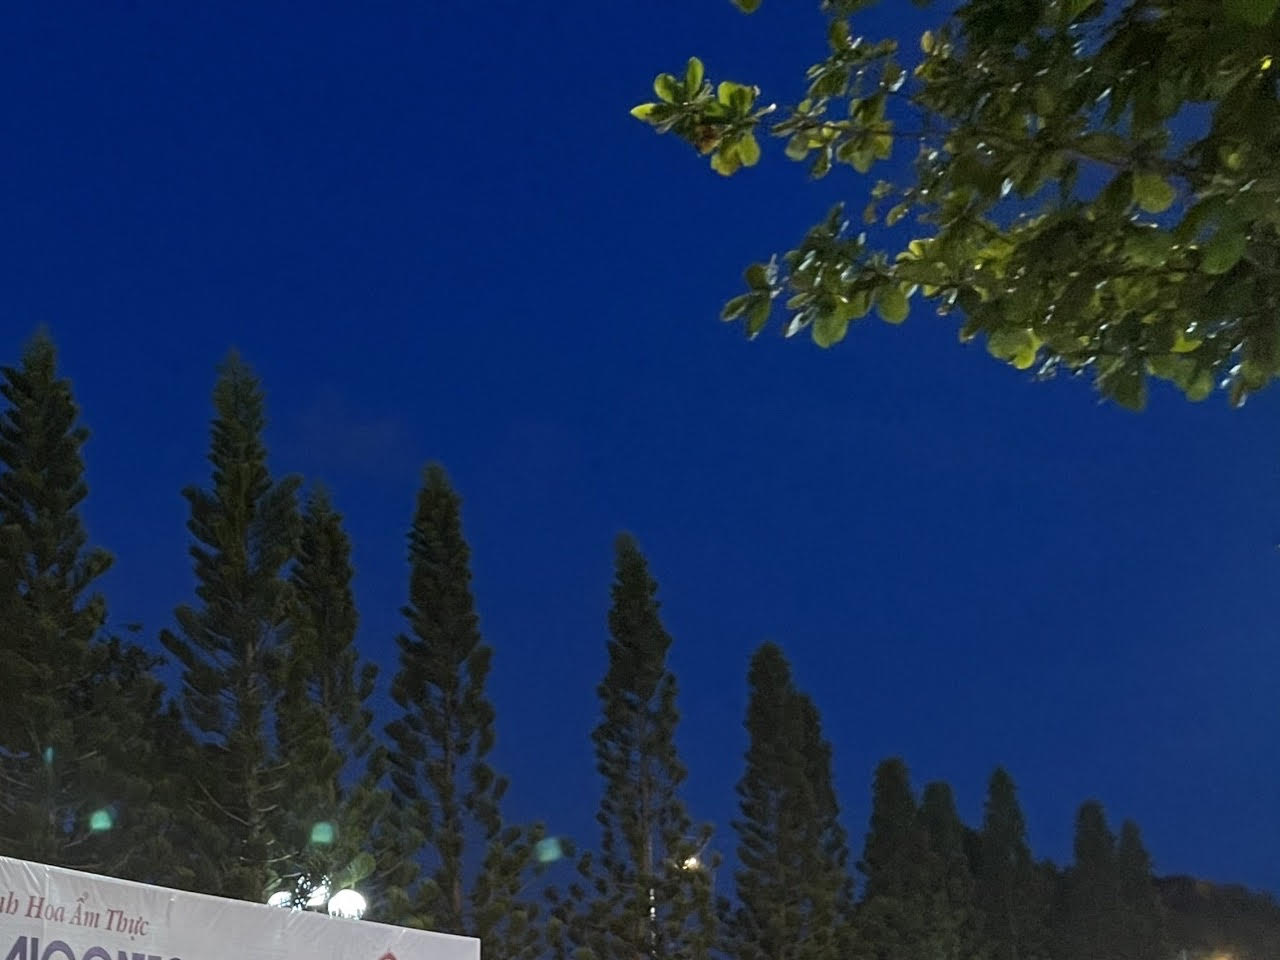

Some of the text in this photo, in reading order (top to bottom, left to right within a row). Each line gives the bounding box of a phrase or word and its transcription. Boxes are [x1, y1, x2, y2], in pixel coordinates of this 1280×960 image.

[24, 895, 65, 923] Hoa
[69, 891, 100, 928] Ẩm
[104, 908, 150, 941] Thực
